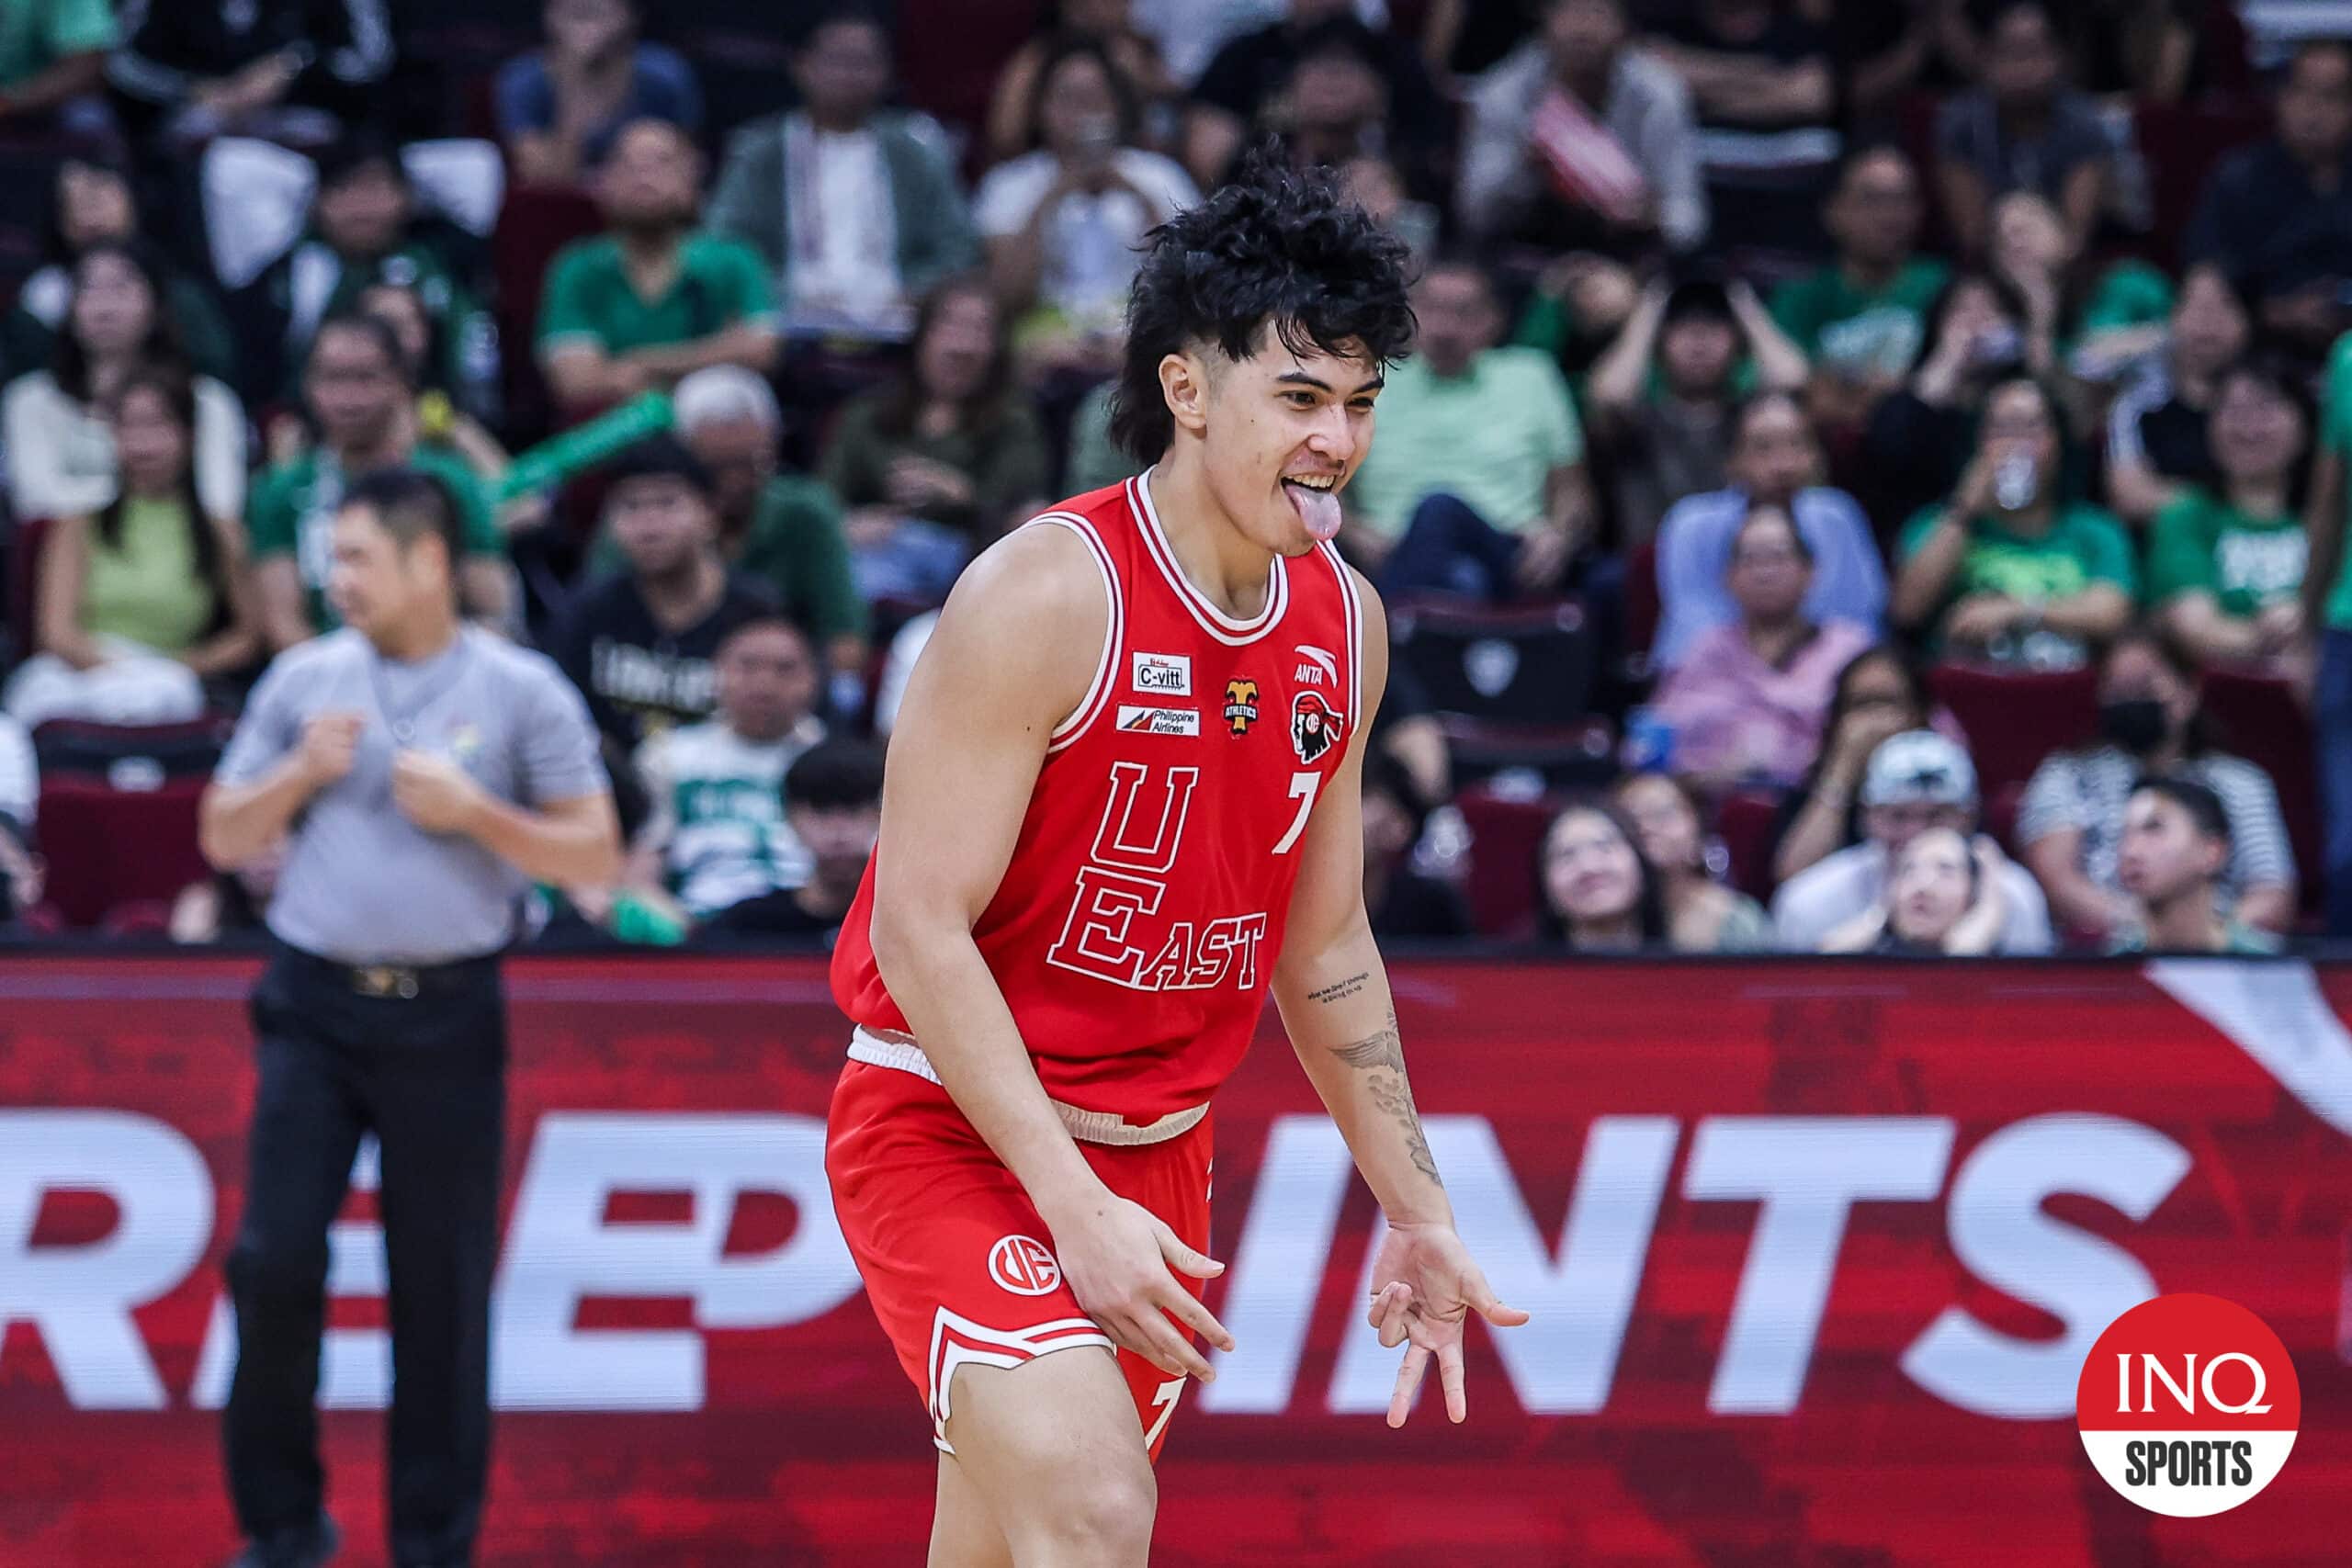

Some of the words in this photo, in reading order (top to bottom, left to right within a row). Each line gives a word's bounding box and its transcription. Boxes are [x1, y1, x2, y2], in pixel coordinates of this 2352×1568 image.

[1141, 667, 1180, 686] C-vitt
[1295, 663, 1323, 685] ANTA
[1154, 709, 1194, 723] Philippine
[1152, 722, 1184, 734] Airlines
[1272, 772, 1322, 854] 7
[1145, 1377, 1187, 1450] 7
